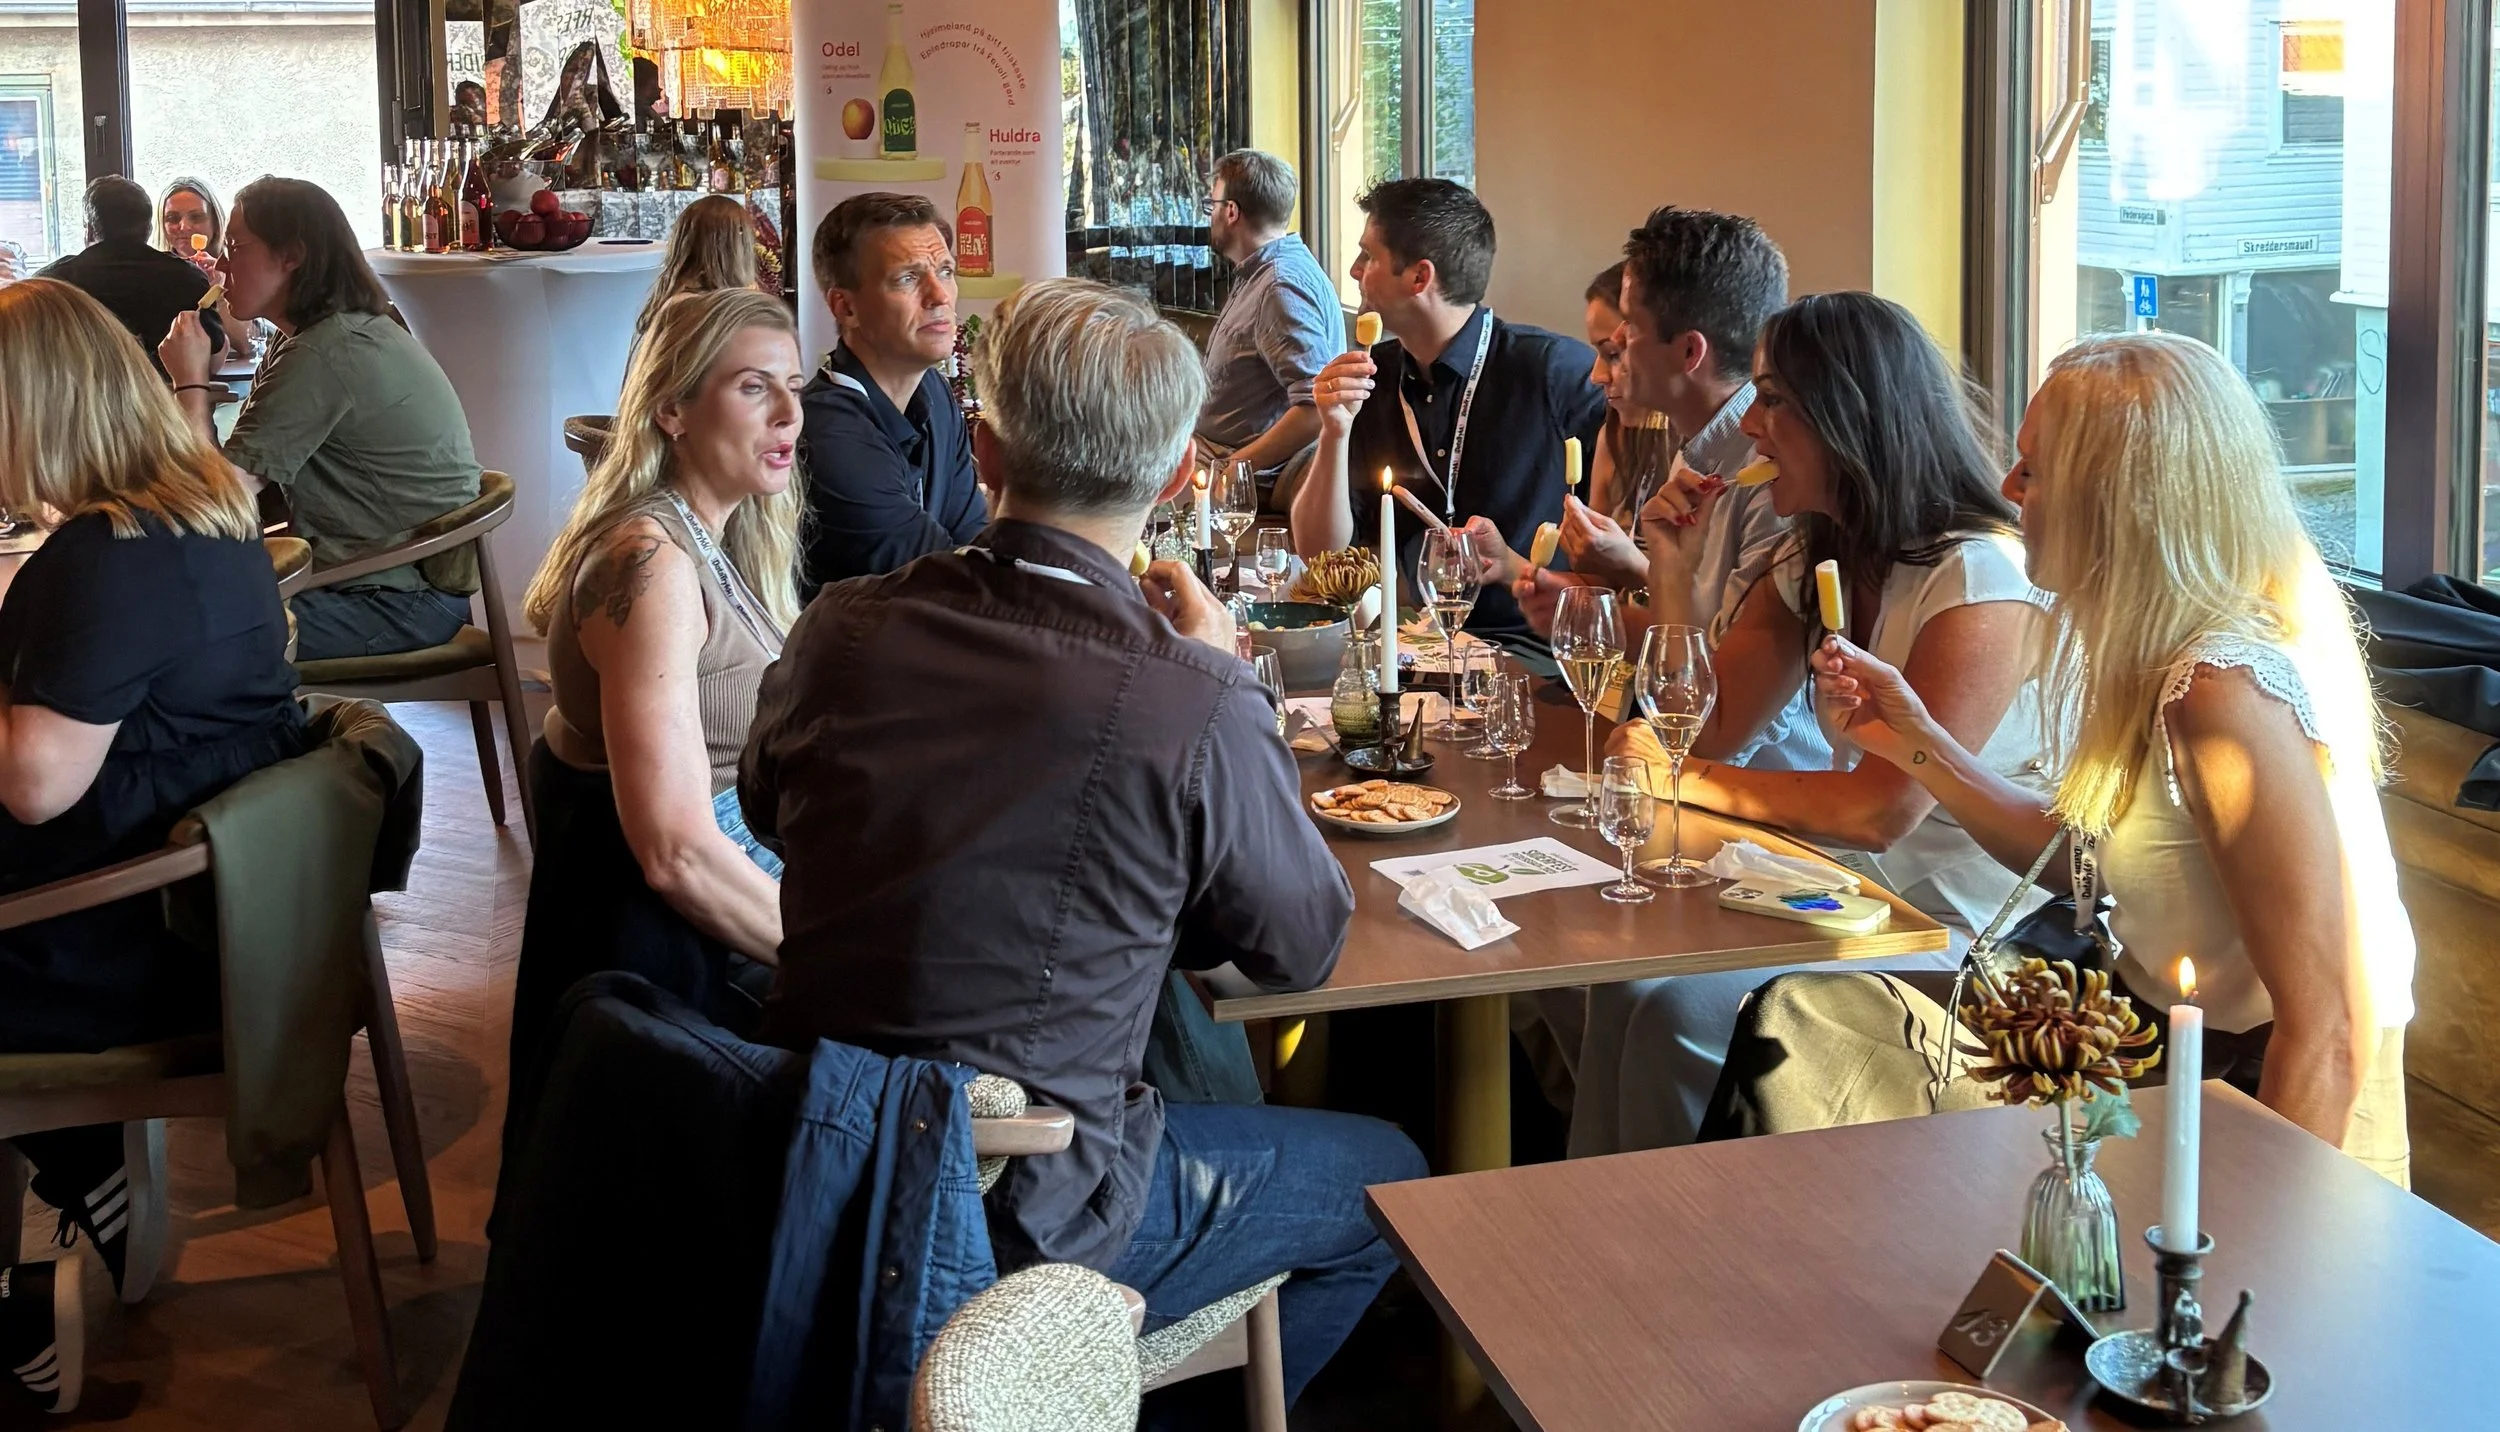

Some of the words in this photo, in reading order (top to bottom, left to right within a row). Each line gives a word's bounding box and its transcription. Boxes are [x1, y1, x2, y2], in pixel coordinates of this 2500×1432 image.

[973, 27, 985, 37] på
[987, 34, 1002, 47] sitt
[822, 41, 860, 57] Odel
[989, 128, 1041, 143] Huldra
[2243, 238, 2313, 253] Skreddersmauet
[1954, 1309, 2009, 1347] 13
